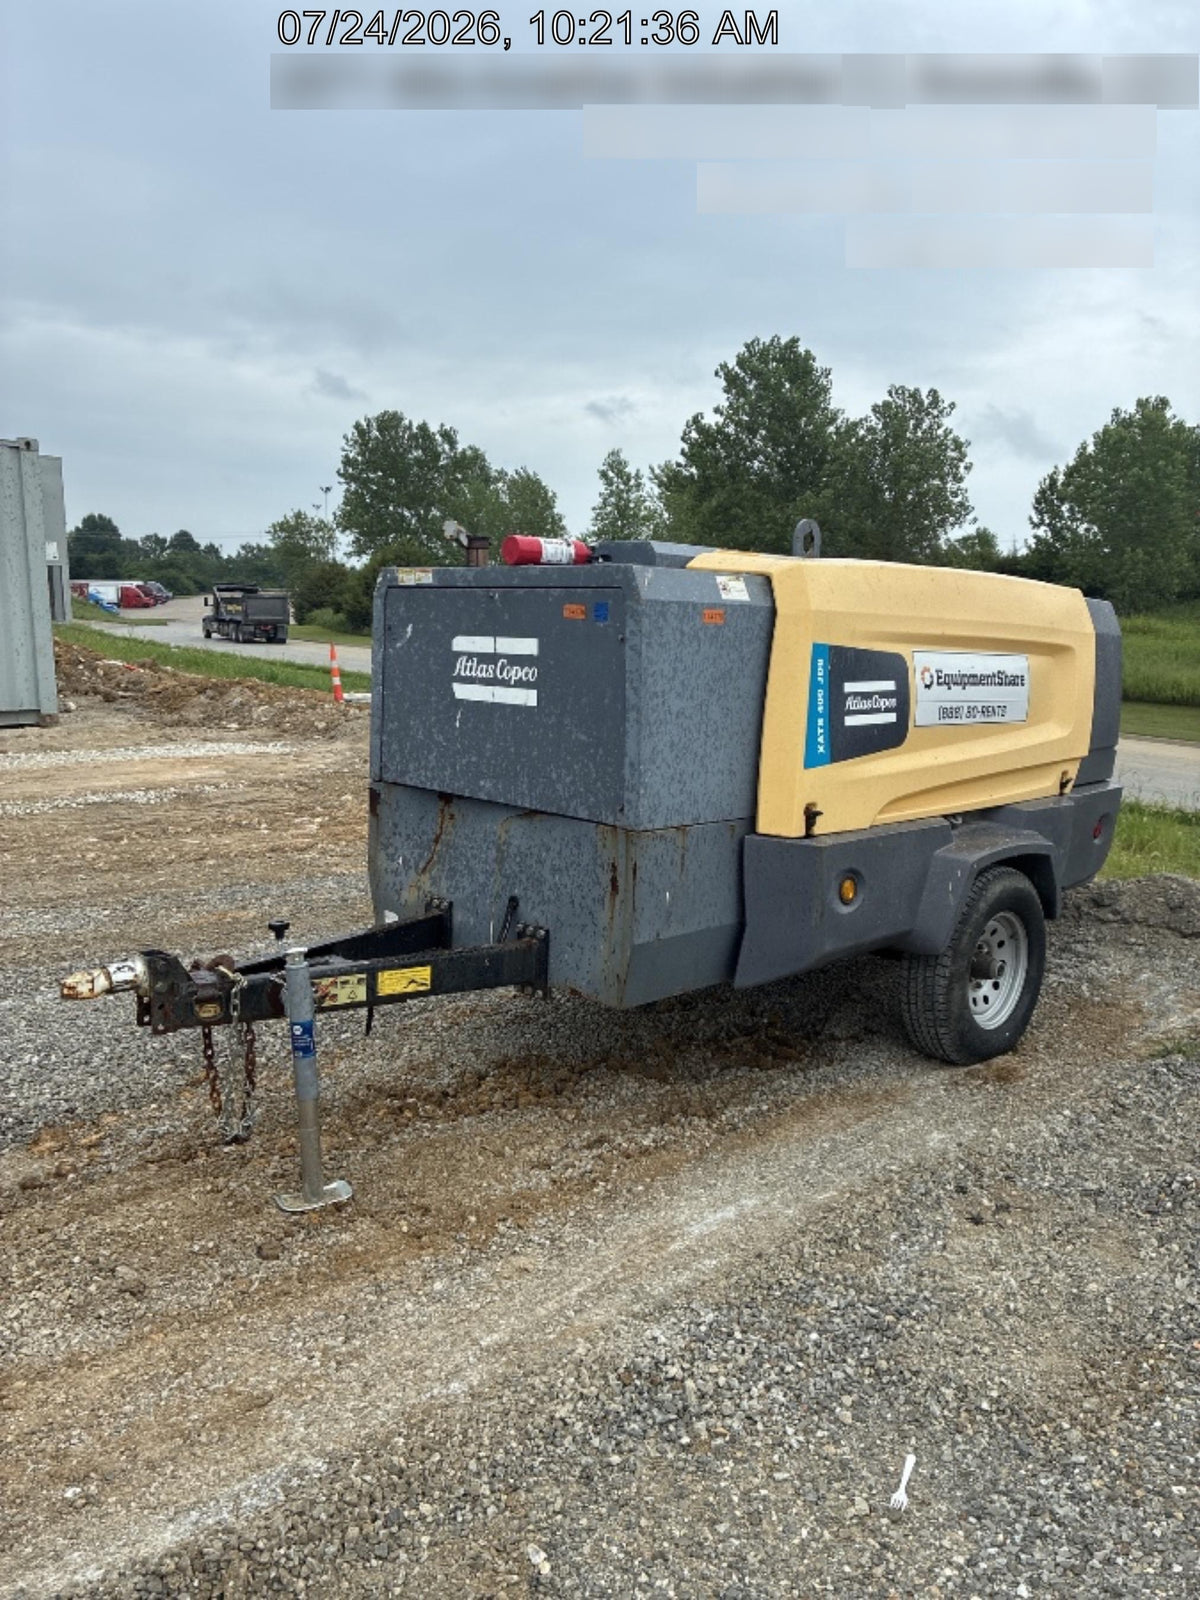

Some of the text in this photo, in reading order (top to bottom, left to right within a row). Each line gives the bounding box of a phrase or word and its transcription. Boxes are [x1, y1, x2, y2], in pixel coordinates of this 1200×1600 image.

[452, 655, 537, 685] Atlas Copco
[935, 669, 1025, 690] EquipmentShare
[844, 695, 897, 712] Atlas Copco
